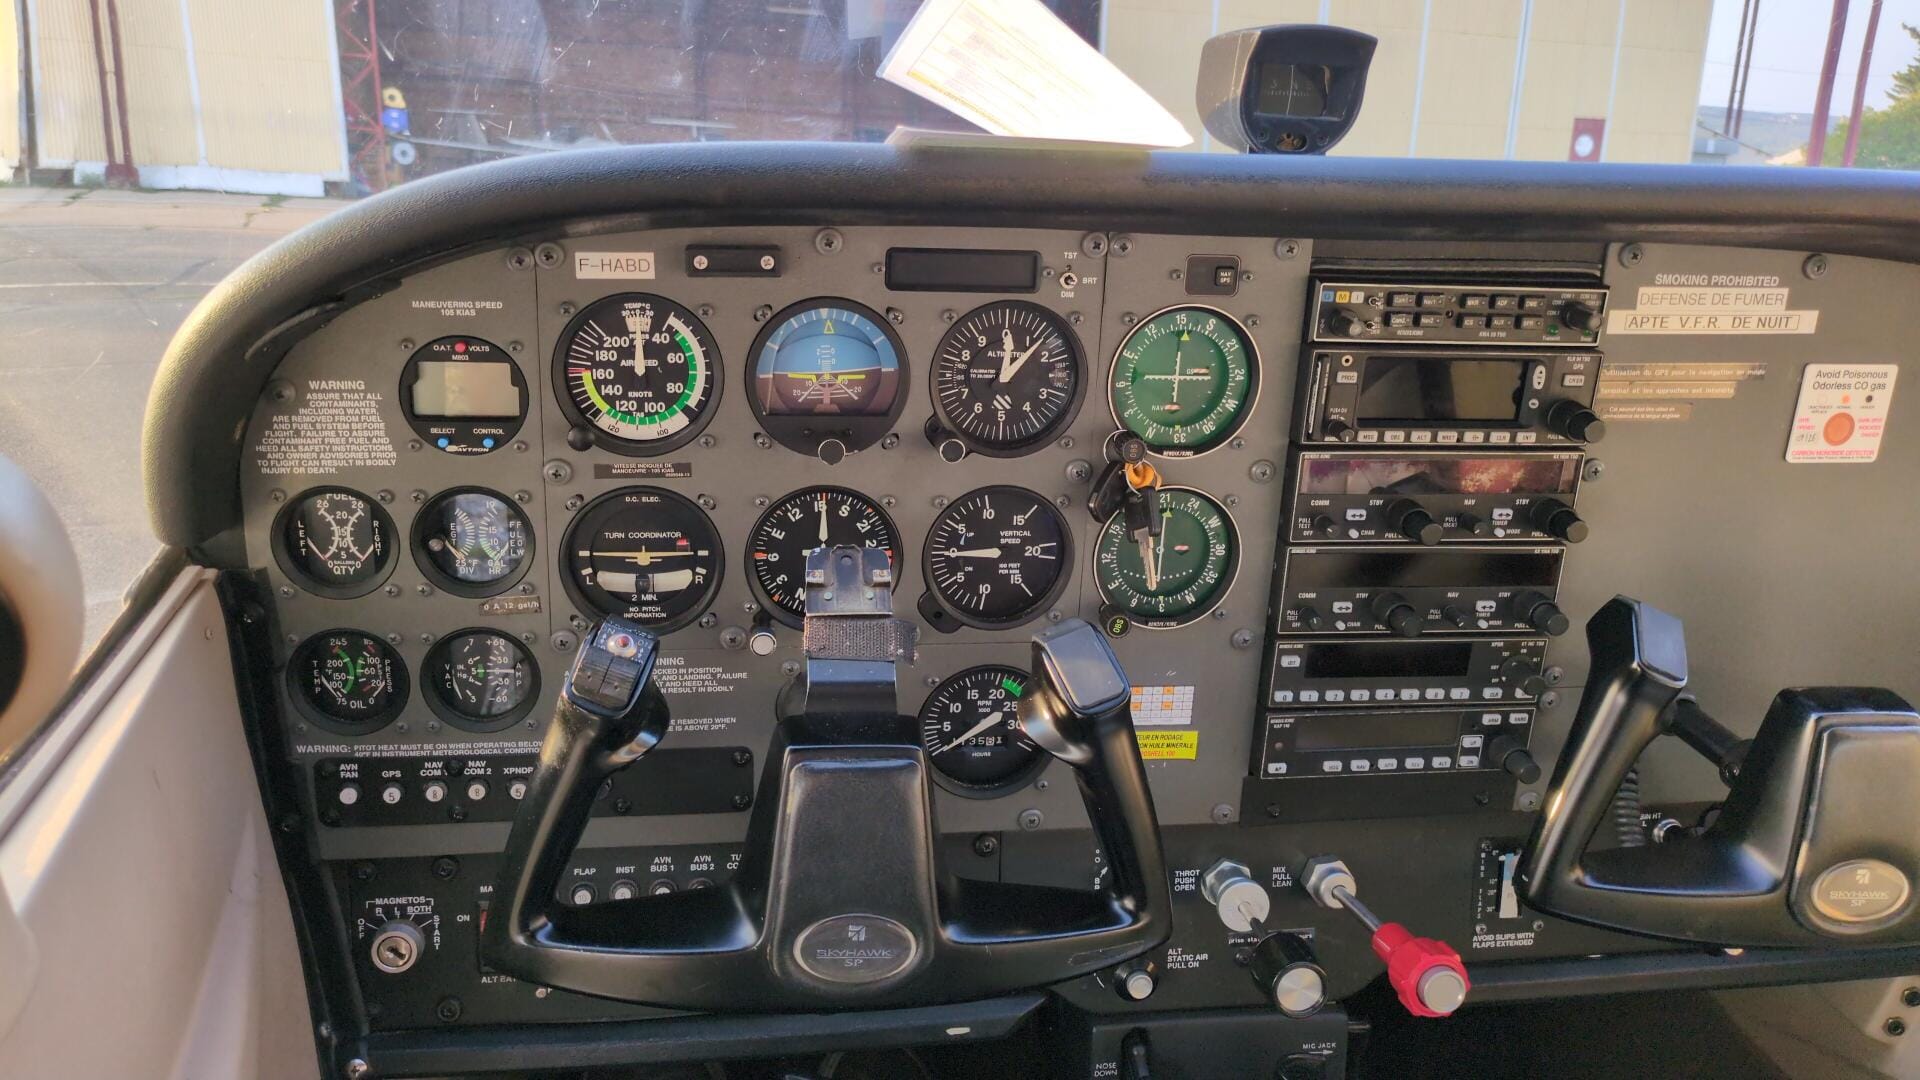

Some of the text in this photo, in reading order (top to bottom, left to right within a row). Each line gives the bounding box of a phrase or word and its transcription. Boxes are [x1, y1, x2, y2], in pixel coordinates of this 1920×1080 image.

[580, 259, 650, 272] F-HABD
[1655, 273, 1779, 286] SMOKING PROHIBITED
[1640, 293, 1785, 305] DEFENSE DE FUMER
[1628, 316, 1792, 328] APTE V.F.R. DE NUIT
[603, 337, 629, 347] 200
[652, 333, 669, 344] 40
[596, 350, 617, 361] 180
[667, 353, 684, 363] 60
[593, 369, 614, 379] 160
[1816, 370, 1888, 378] Avoid Poisonous
[309, 381, 365, 390] WARNING
[602, 385, 622, 395] 140
[667, 383, 683, 393] 80
[1812, 382, 1886, 391] Odorless CO gas
[616, 400, 637, 411] 120
[645, 402, 665, 412] 100
[346, 408, 379, 416] WATER,
[333, 566, 355, 575] QTY
[586, 576, 593, 585] L
[695, 576, 703, 584] R
[296, 745, 351, 753] WARNING:
[433, 748, 502, 756] METEOROLOGICAL
[574, 868, 596, 876] FLAP
[376, 896, 426, 905] MAGNETOS
[1094, 1069, 1118, 1077] DOWN
